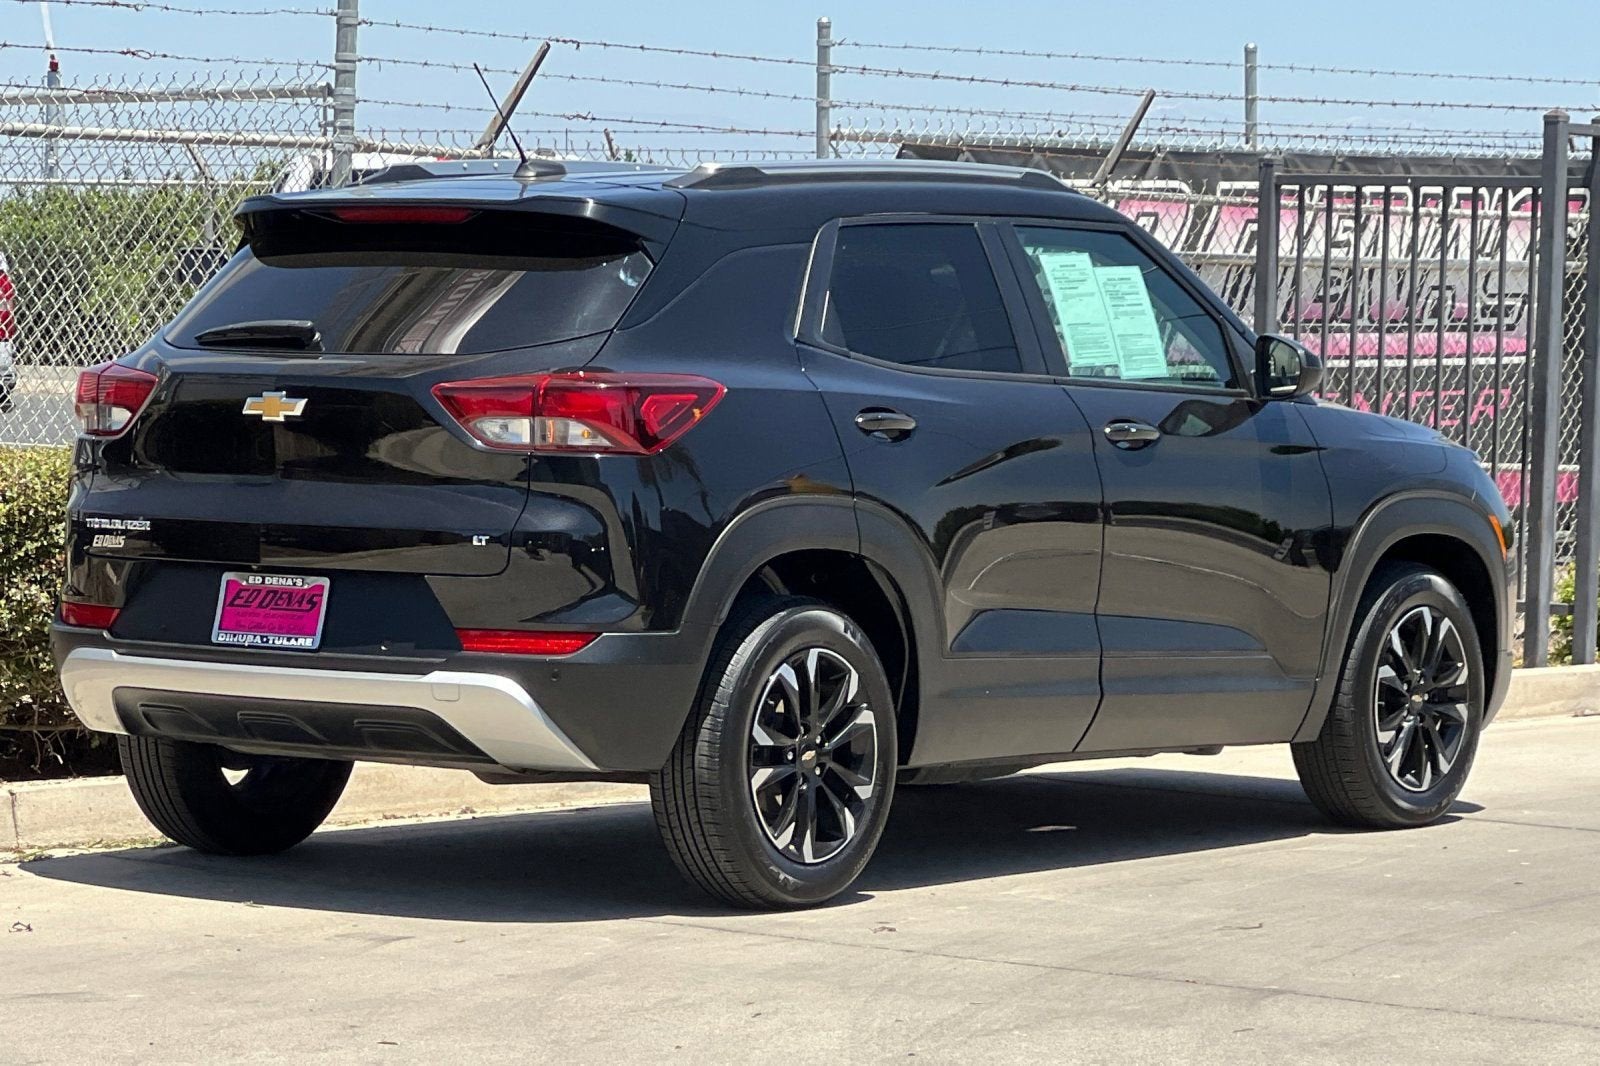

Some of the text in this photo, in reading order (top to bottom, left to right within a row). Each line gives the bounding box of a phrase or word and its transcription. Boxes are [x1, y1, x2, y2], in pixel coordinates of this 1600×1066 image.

[472, 535, 490, 546] LT
[248, 576, 303, 586] ED DENA'S
[227, 588, 259, 608] ED
[218, 633, 314, 647] DINUBA TULARE
